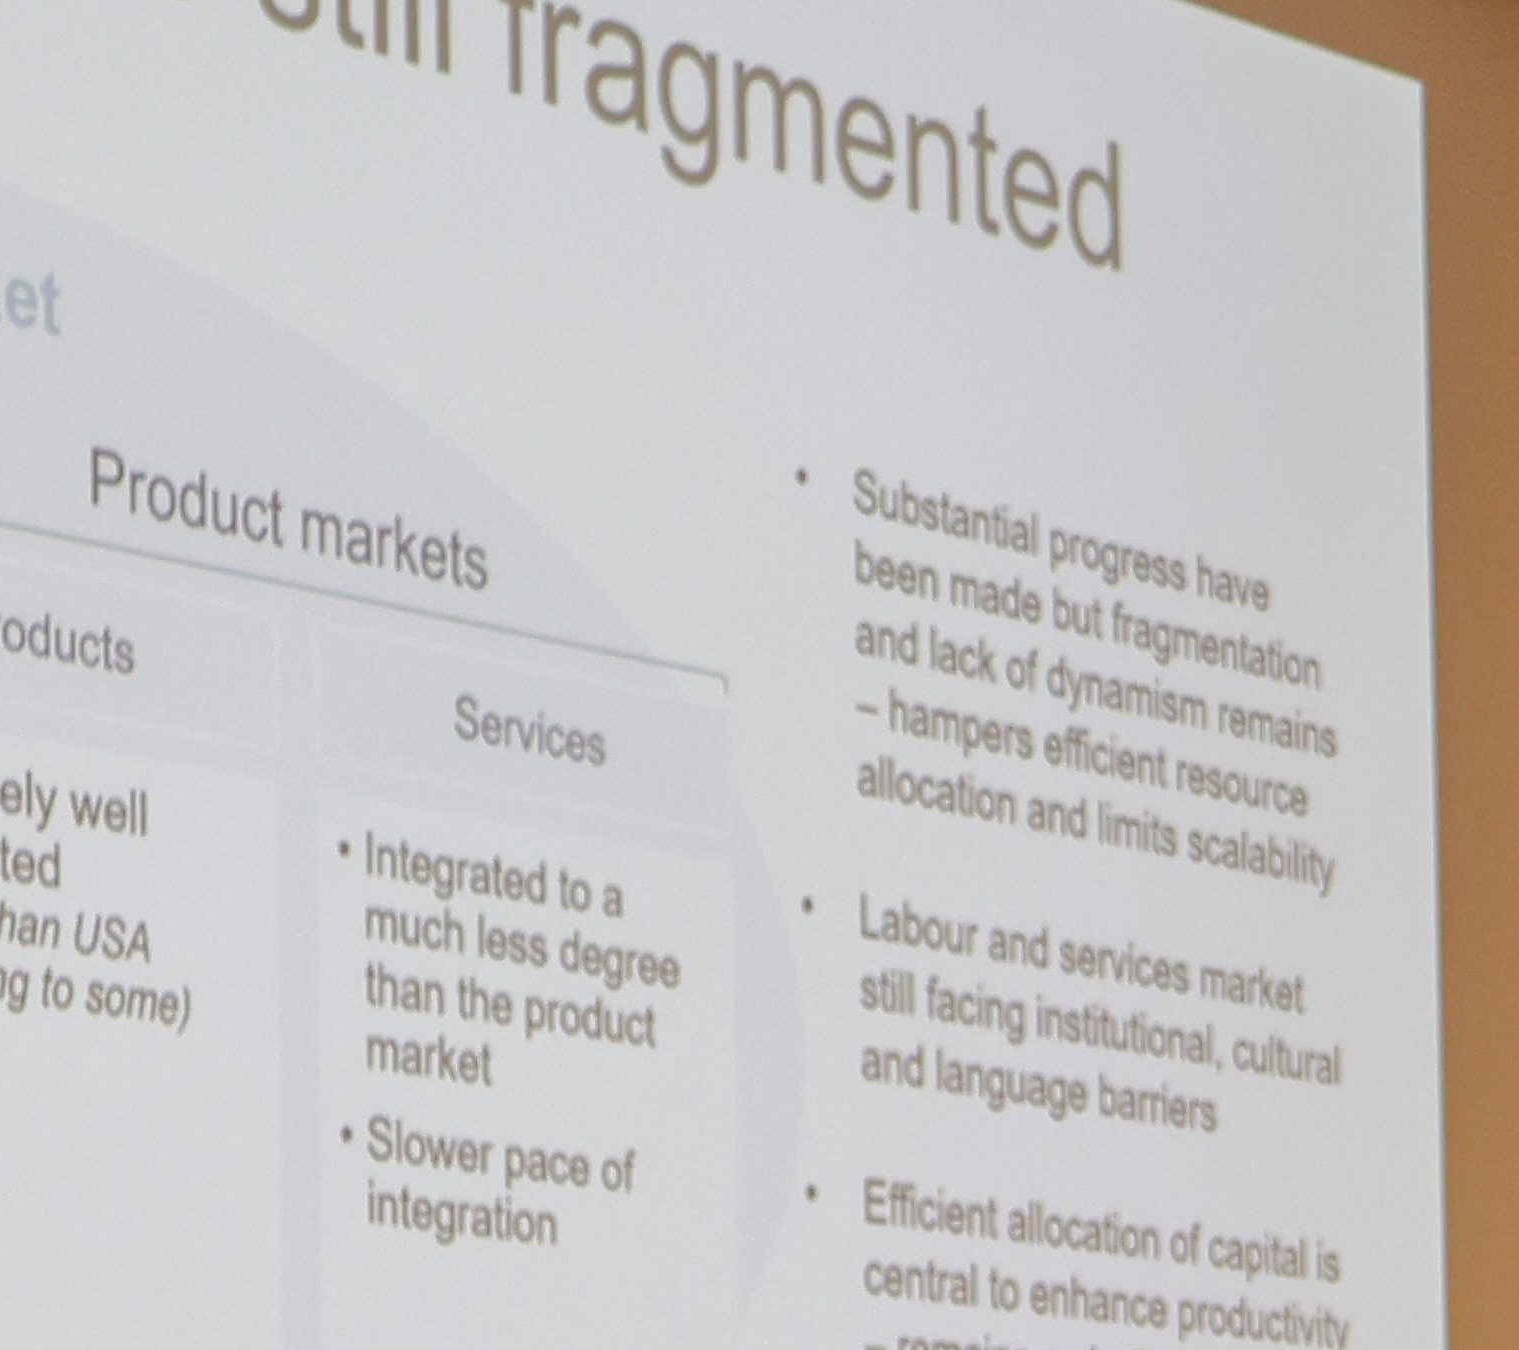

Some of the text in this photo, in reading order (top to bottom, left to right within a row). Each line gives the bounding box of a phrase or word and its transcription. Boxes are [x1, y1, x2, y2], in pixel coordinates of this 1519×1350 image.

[501, 0, 1123, 272] fragmented
[91, 446, 488, 590] Product markets
[854, 468, 1270, 612] Substantial progress have
[855, 539, 1321, 688] been made but fragmentation
[455, 694, 607, 766] Services
[855, 621, 1338, 758] and lack of dynamism remains
[889, 688, 1034, 760] hampers
[1044, 726, 1167, 788] efficient
[1177, 761, 1309, 817] resource
[70, 789, 147, 836] well
[857, 755, 1335, 898] allocation and limits scalability
[366, 831, 623, 917] Integrated to a
[74, 912, 150, 963] USA
[365, 907, 680, 991] much less degree
[860, 893, 1304, 1014] Labour and services market
[42, 966, 74, 1010] to
[85, 981, 191, 1033] some)
[366, 962, 656, 1048] than the product
[860, 969, 1342, 1085] still facing institutional, cultural
[367, 1035, 491, 1086] market
[861, 1045, 1217, 1133] and language barriers
[368, 1114, 636, 1192] Slower pace of
[368, 1186, 557, 1245] integration
[864, 1177, 1341, 1284] Efficient allocation of capital is
[864, 1260, 978, 1306] central
[989, 1269, 1020, 1312] to
[1030, 1276, 1168, 1329] enhance
